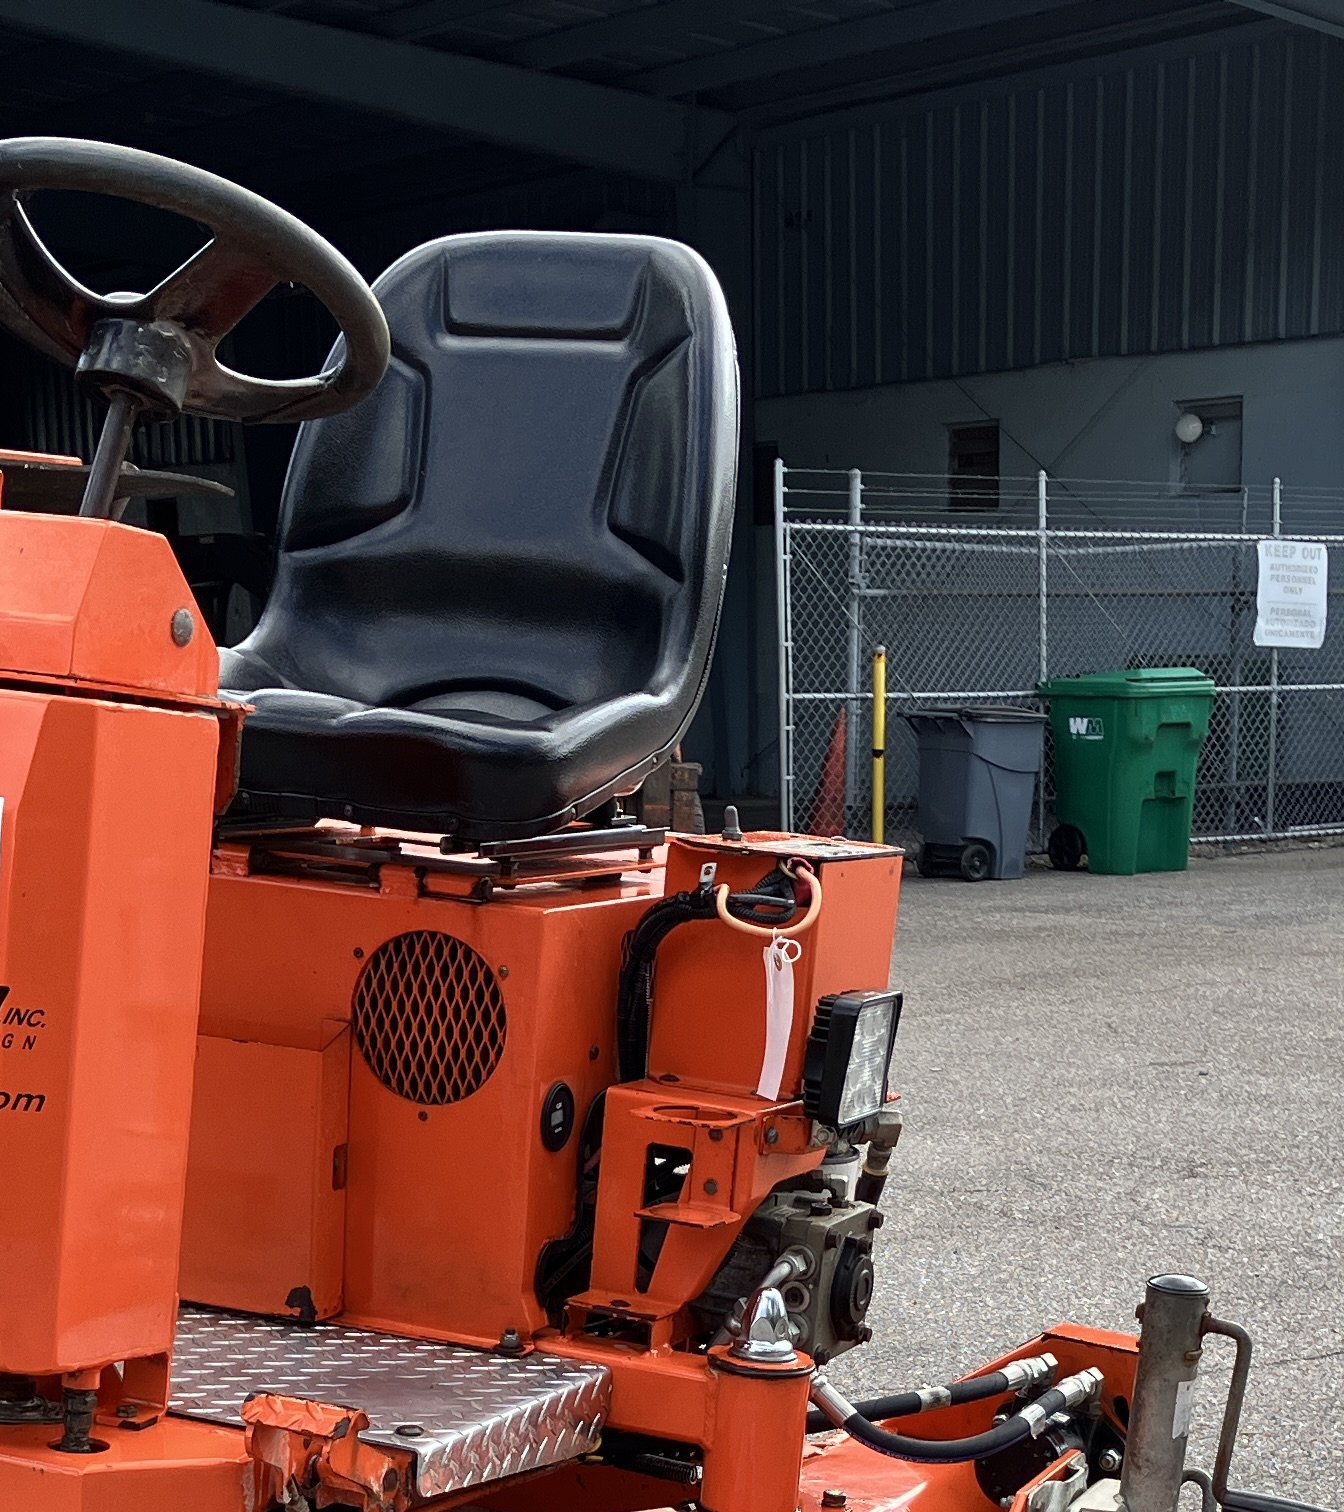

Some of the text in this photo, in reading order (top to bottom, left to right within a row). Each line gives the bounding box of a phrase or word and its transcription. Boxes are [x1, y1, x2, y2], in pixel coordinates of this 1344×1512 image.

[1265, 544, 1322, 560] KEEP OUT
[1270, 563, 1319, 575] AUTHORIZED
[1270, 574, 1317, 585] PERSONNEL
[1283, 586, 1303, 595] ONLY
